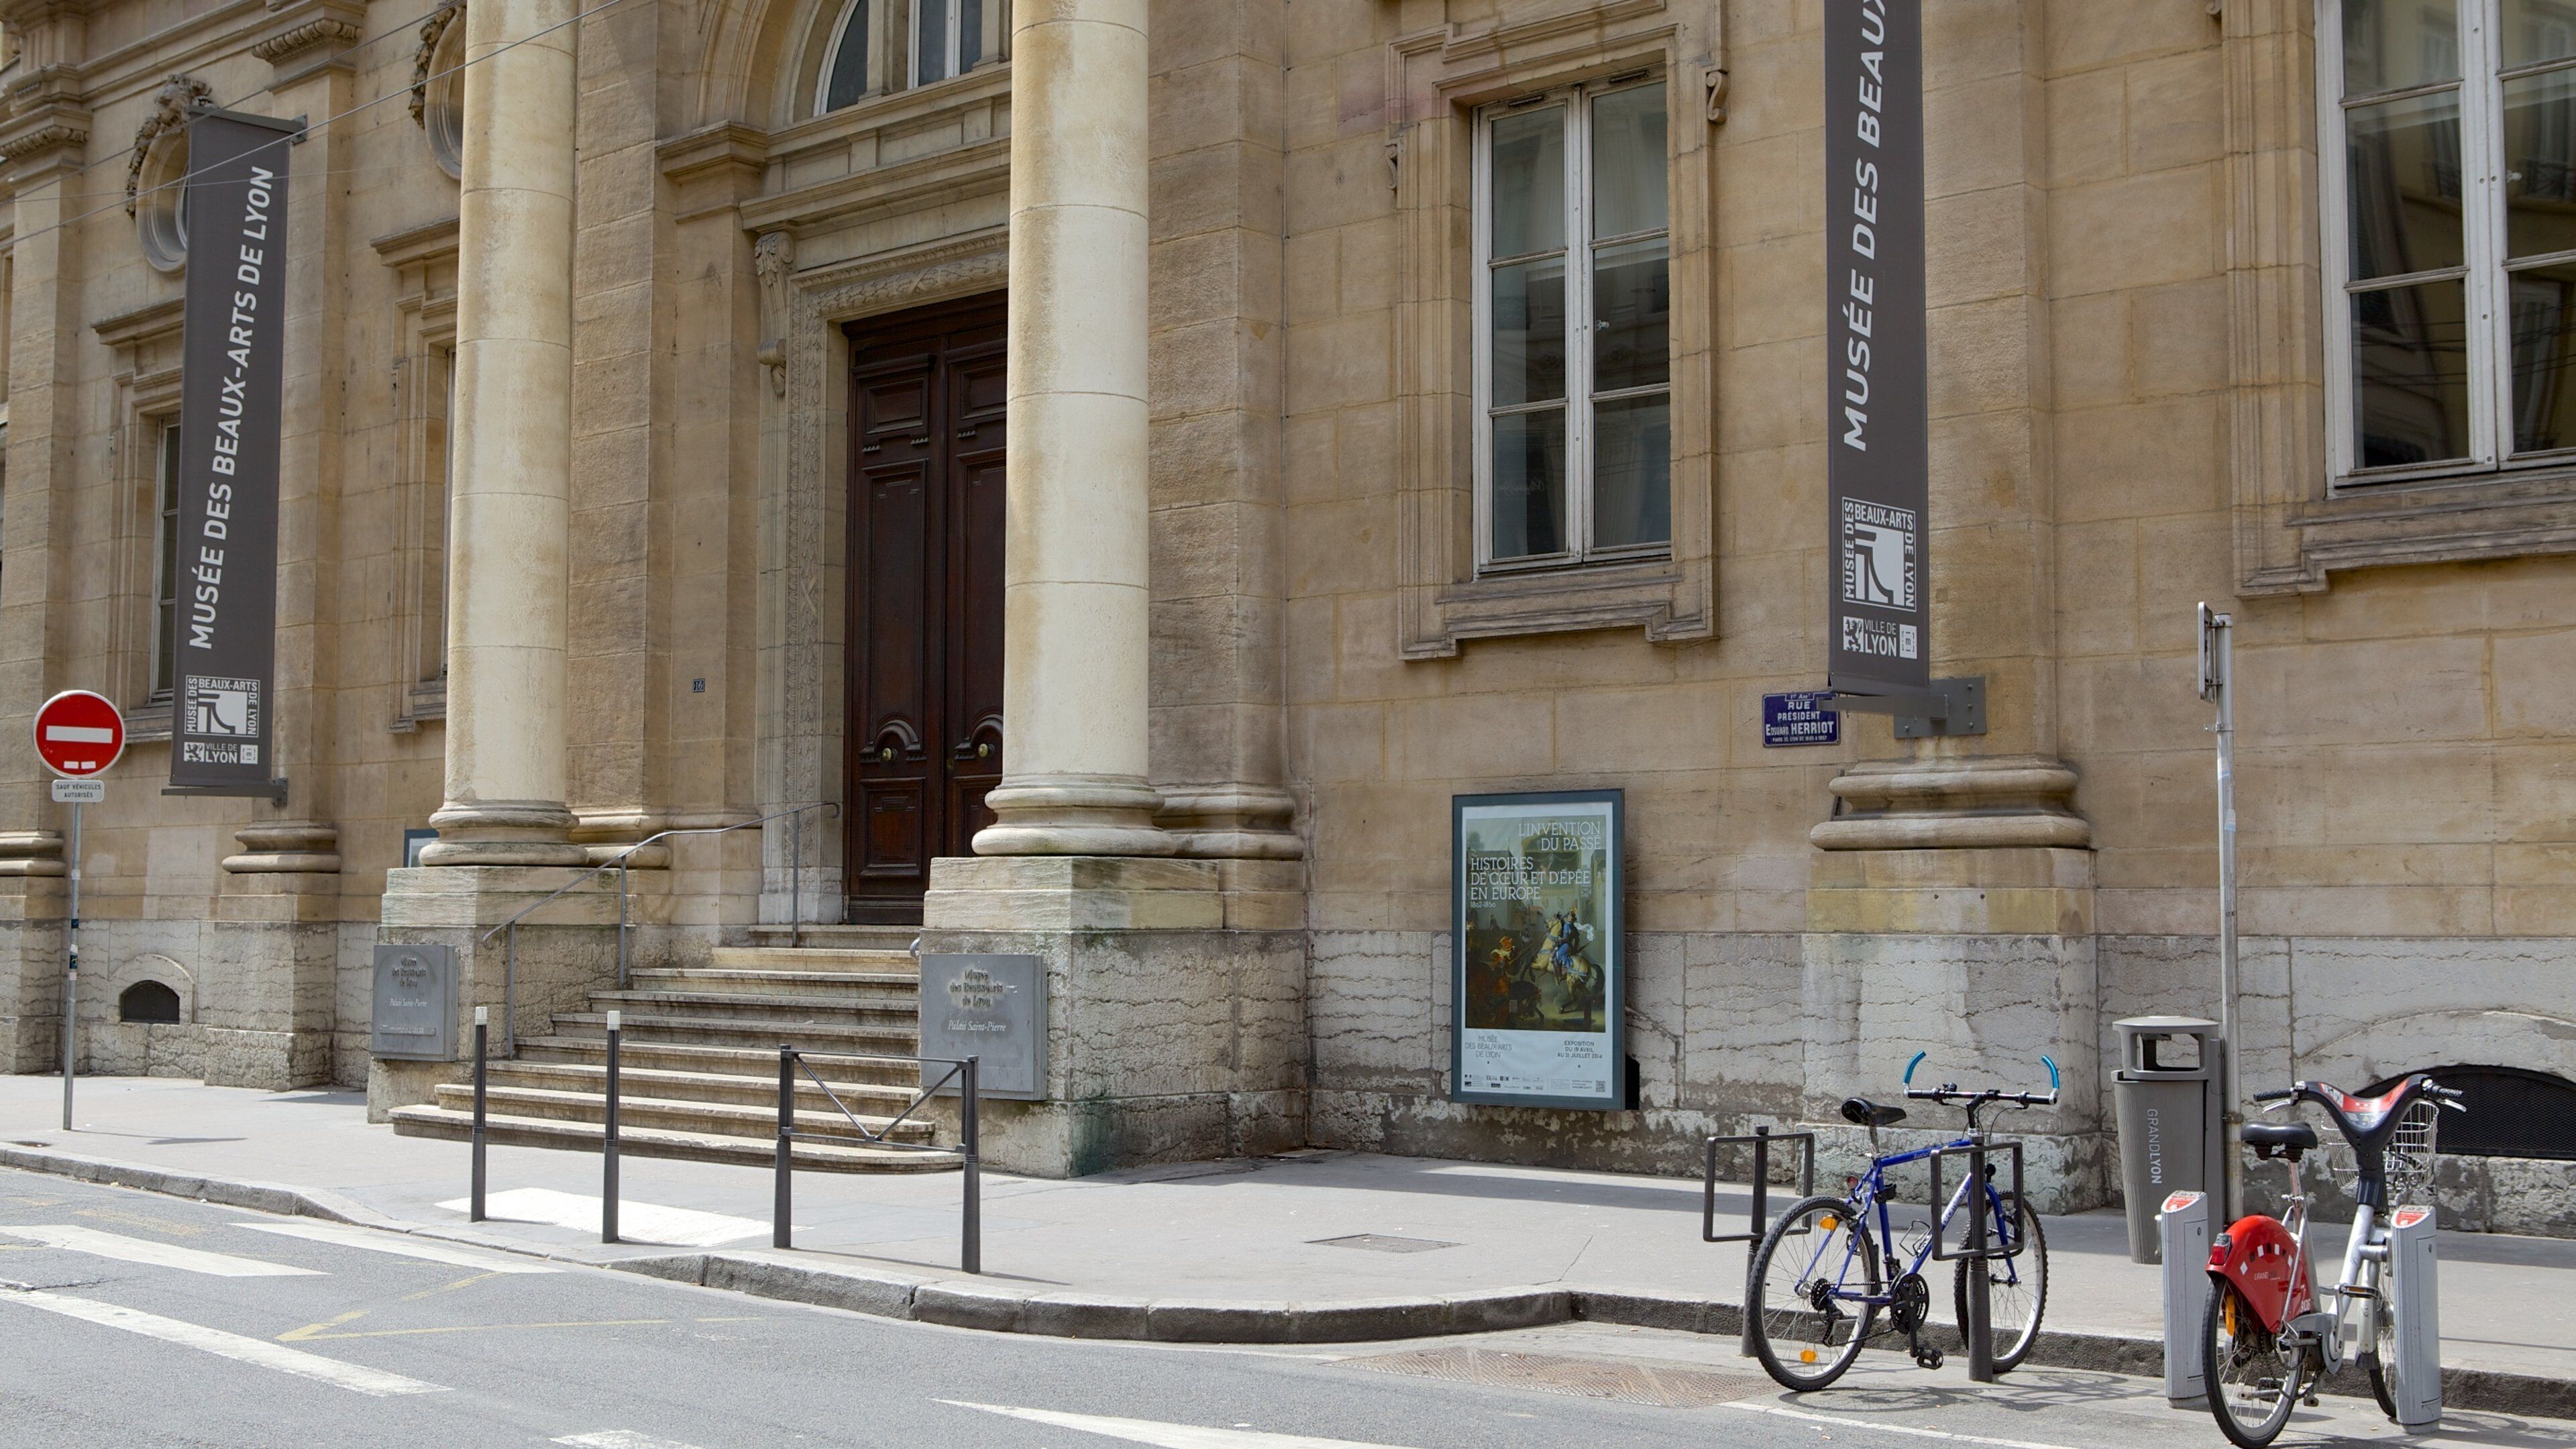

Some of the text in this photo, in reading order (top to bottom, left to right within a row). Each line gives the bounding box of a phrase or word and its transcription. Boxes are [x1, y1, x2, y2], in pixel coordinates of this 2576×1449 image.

[1852, 157, 1878, 260] DES
[1842, 268, 1874, 451] MUSÉE
[189, 166, 274, 649] MUSÉE DES BEAUX-ARTS DE LYON
[1855, 503, 1913, 531] BEAUX-ARTS
[1845, 502, 1855, 599] MUSEE DES
[1904, 532, 1915, 607] DE LYON
[1864, 619, 1896, 635] VILLE DE
[1865, 633, 1897, 657] LYON
[199, 678, 258, 692] BEAUX-ARTS
[187, 678, 198, 733] MUSEE DES
[248, 692, 258, 706] DE
[1788, 702, 1811, 710] RUE
[248, 709, 257, 735] LYON
[1791, 722, 1834, 735] HERRIOT
[205, 743, 225, 751] VILLE
[205, 751, 237, 763] LYON
[1519, 821, 1601, 837] L'INVENTION
[1541, 835, 1601, 851] DU PASSÉ
[1470, 856, 1534, 871] HISTOIRES
[1470, 869, 1591, 885] DE CŒUR ET D'ÉPÉE
[1470, 886, 1541, 900] EN EUROPE
[947, 1020, 1006, 1031] Palais Saint-Pierre
[1478, 1034, 1498, 1042] MUSÉE
[1464, 1042, 1513, 1051] DES BEAUX-ARTS
[1476, 1050, 1501, 1059] DE LYON
